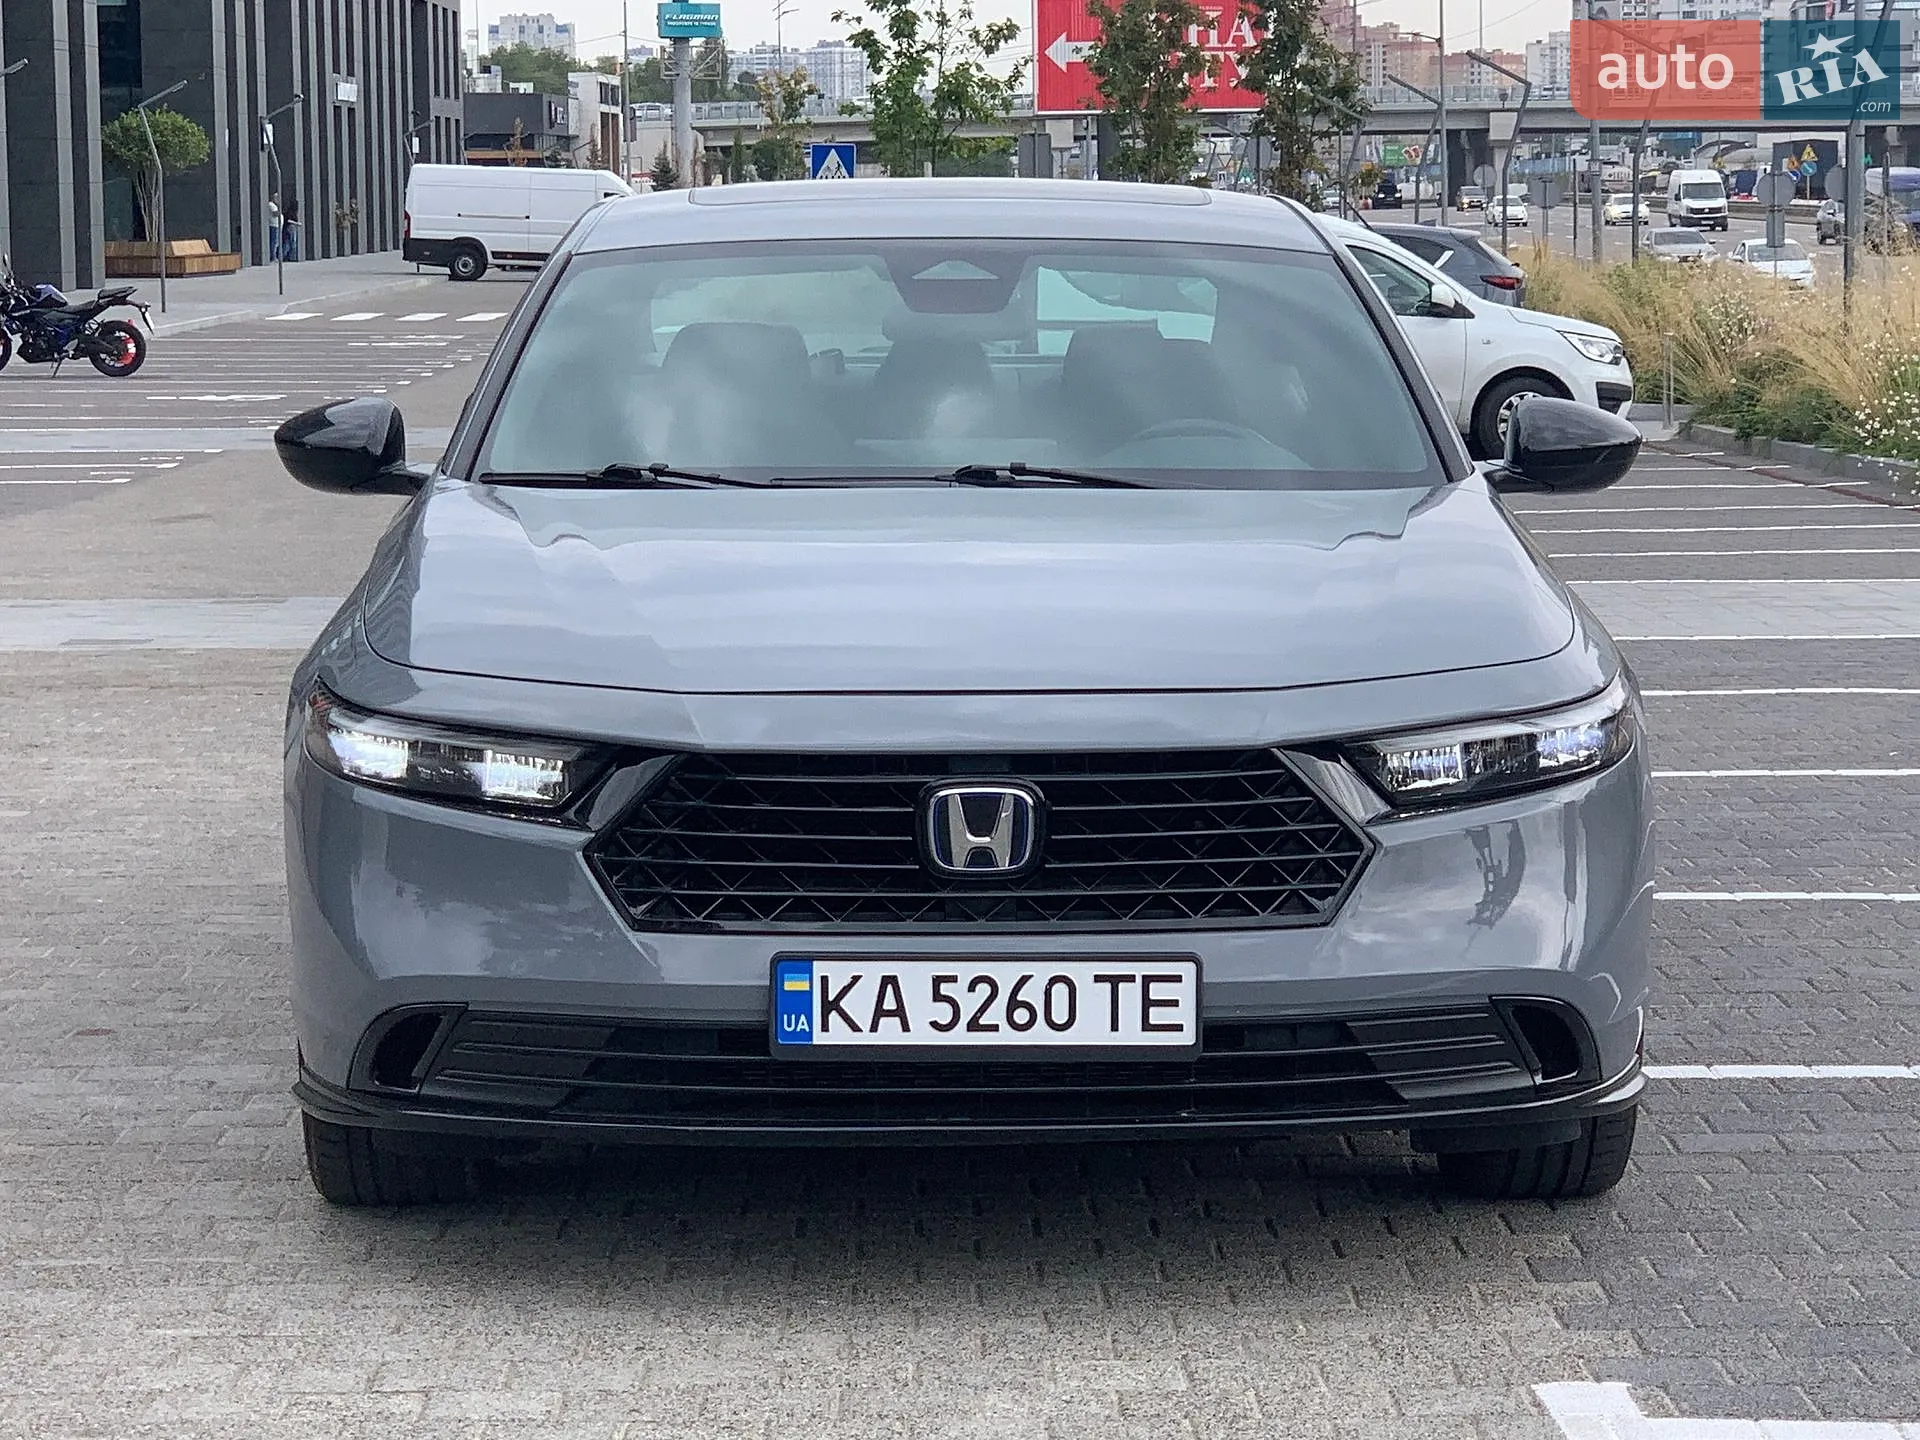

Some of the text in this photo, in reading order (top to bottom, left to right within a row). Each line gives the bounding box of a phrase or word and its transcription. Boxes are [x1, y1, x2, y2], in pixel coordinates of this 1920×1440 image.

[819, 974, 1184, 1033] KA 5260 TE
[783, 1014, 810, 1032] UA
